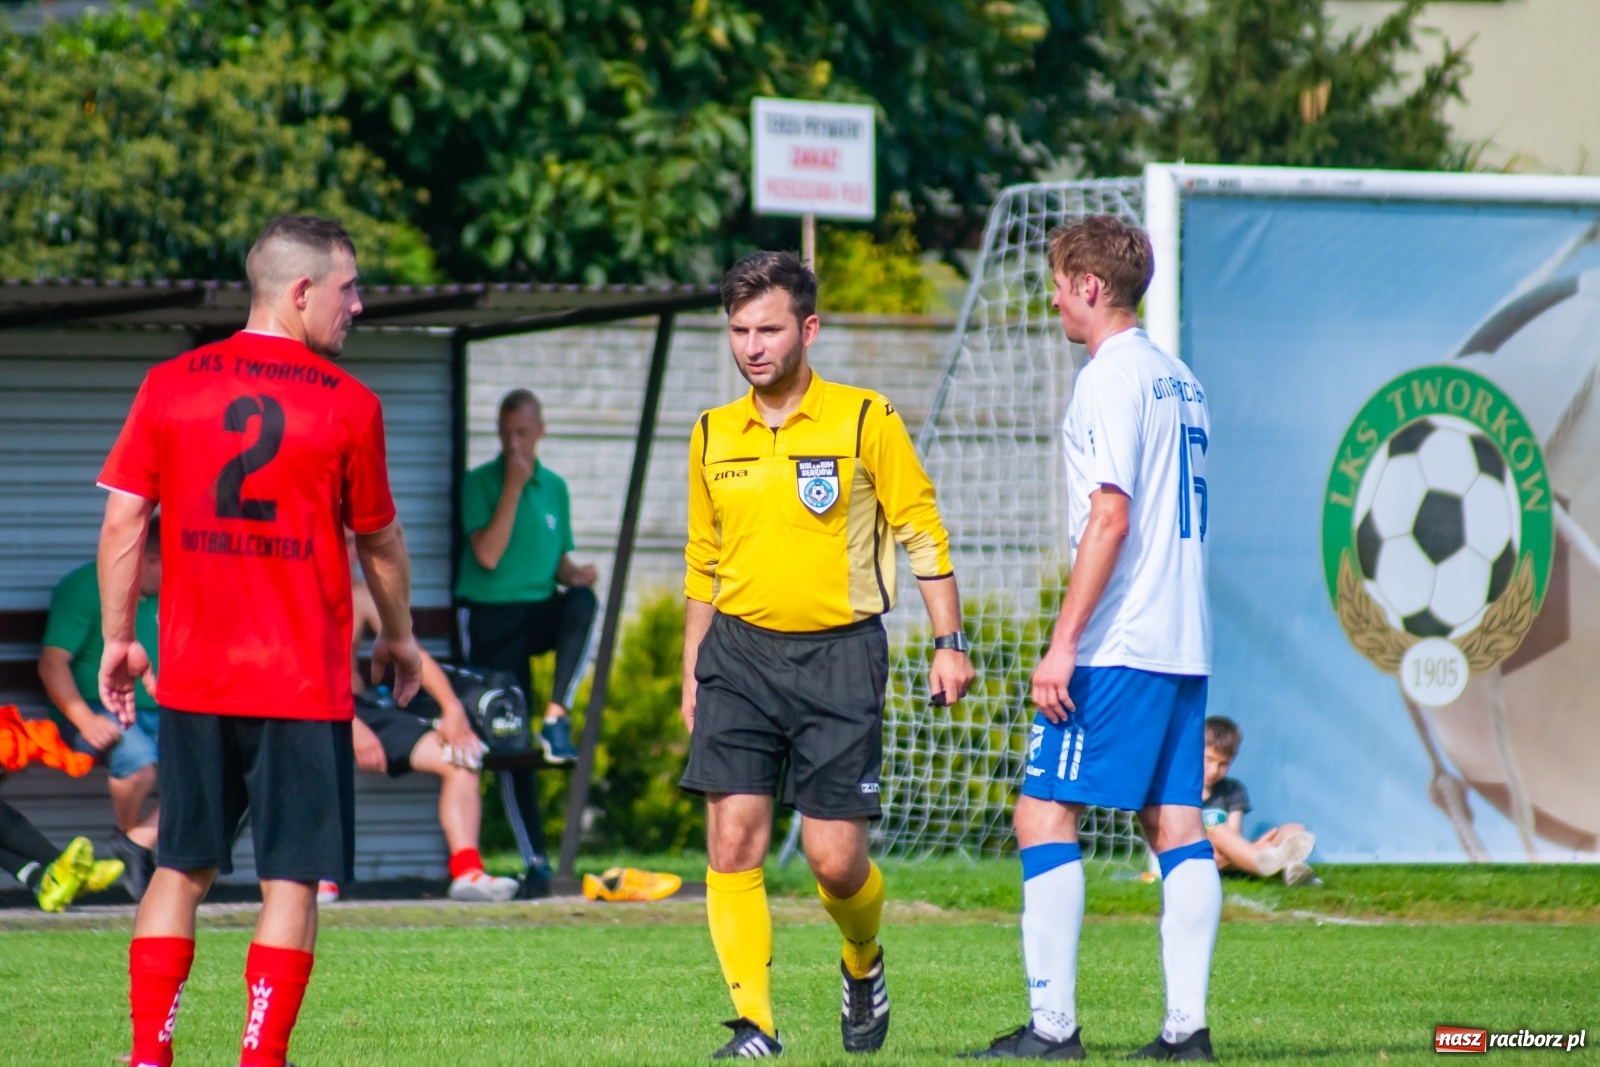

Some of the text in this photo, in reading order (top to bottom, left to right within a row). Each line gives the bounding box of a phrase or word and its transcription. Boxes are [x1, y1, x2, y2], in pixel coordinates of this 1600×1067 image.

[188, 353, 224, 373] LKS
[216, 394, 285, 522] 2
[1330, 420, 1378, 508] LKS
[1413, 657, 1458, 688] 1905
